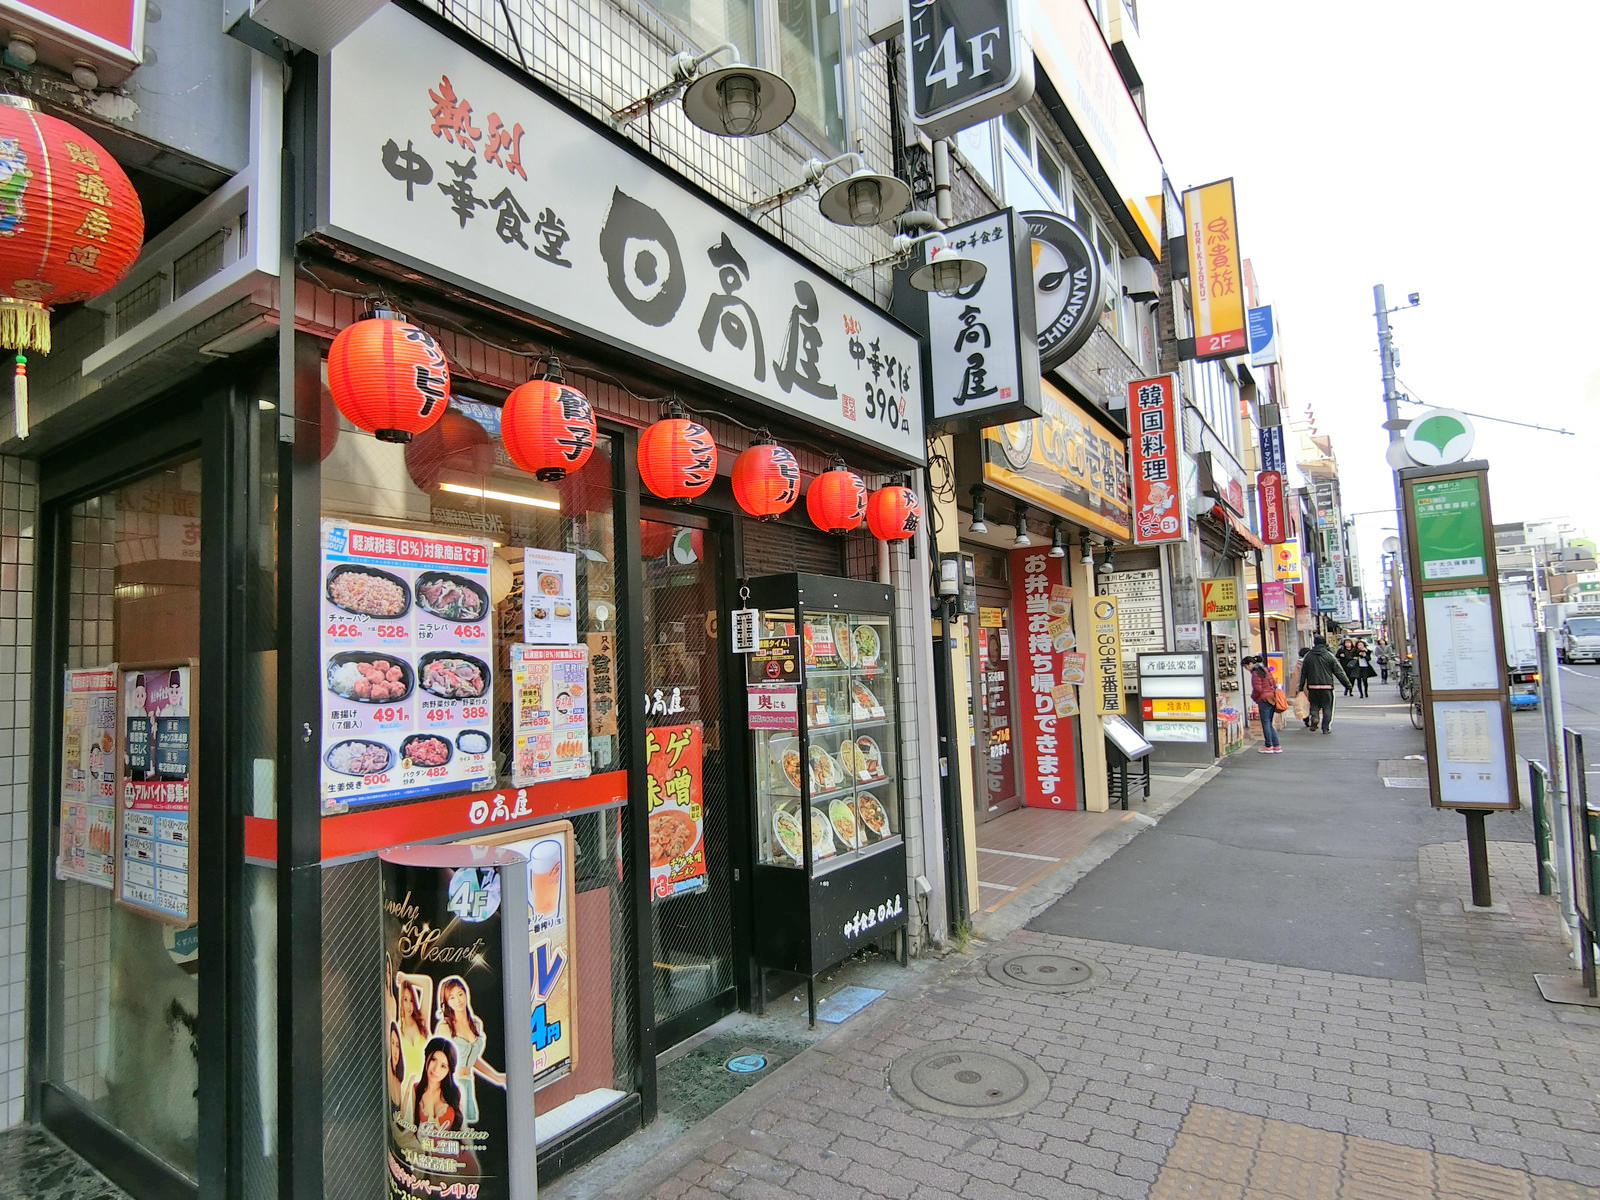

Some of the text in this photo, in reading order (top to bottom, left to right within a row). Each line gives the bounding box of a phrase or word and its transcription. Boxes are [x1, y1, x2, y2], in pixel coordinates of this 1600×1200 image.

[925, 25, 1000, 89] 4F
[428, 75, 528, 181] 熱烈
[381, 139, 573, 269] 中華食堂
[956, 226, 1004, 252] 中華食堂
[1209, 334, 1231, 351] 2F
[848, 335, 911, 394] 中華そば
[1138, 383, 1169, 482] 韓国料理
[684, 422, 714, 488] タンメン
[771, 446, 799, 504] 生ビール
[899, 489, 922, 533] 炒飯
[1162, 518, 1177, 530] B1
[1101, 588, 1107, 596] 6
[329, 614, 370, 623] チャーハン
[419, 623, 448, 631] ニラレバ
[327, 623, 362, 637] 426円
[419, 631, 434, 639] 炒め
[454, 624, 486, 638] 463円
[1024, 555, 1061, 804] お弁当お持ち帰りできます。
[1097, 634, 1121, 711] CoCo壱番屋
[422, 700, 457, 708] 肉野菜炒め
[758, 694, 787, 710] 奥にも
[331, 710, 357, 720] 唐揚げ
[373, 707, 410, 722] 491円
[646, 728, 693, 768] チゲ
[327, 781, 363, 793] 生姜焼き
[468, 789, 533, 825] 日高屋
[670, 851, 703, 869] チゲ味噌
[670, 868, 696, 881] ラーメン
[448, 881, 488, 917] 4F
[399, 928, 485, 961] Heart
